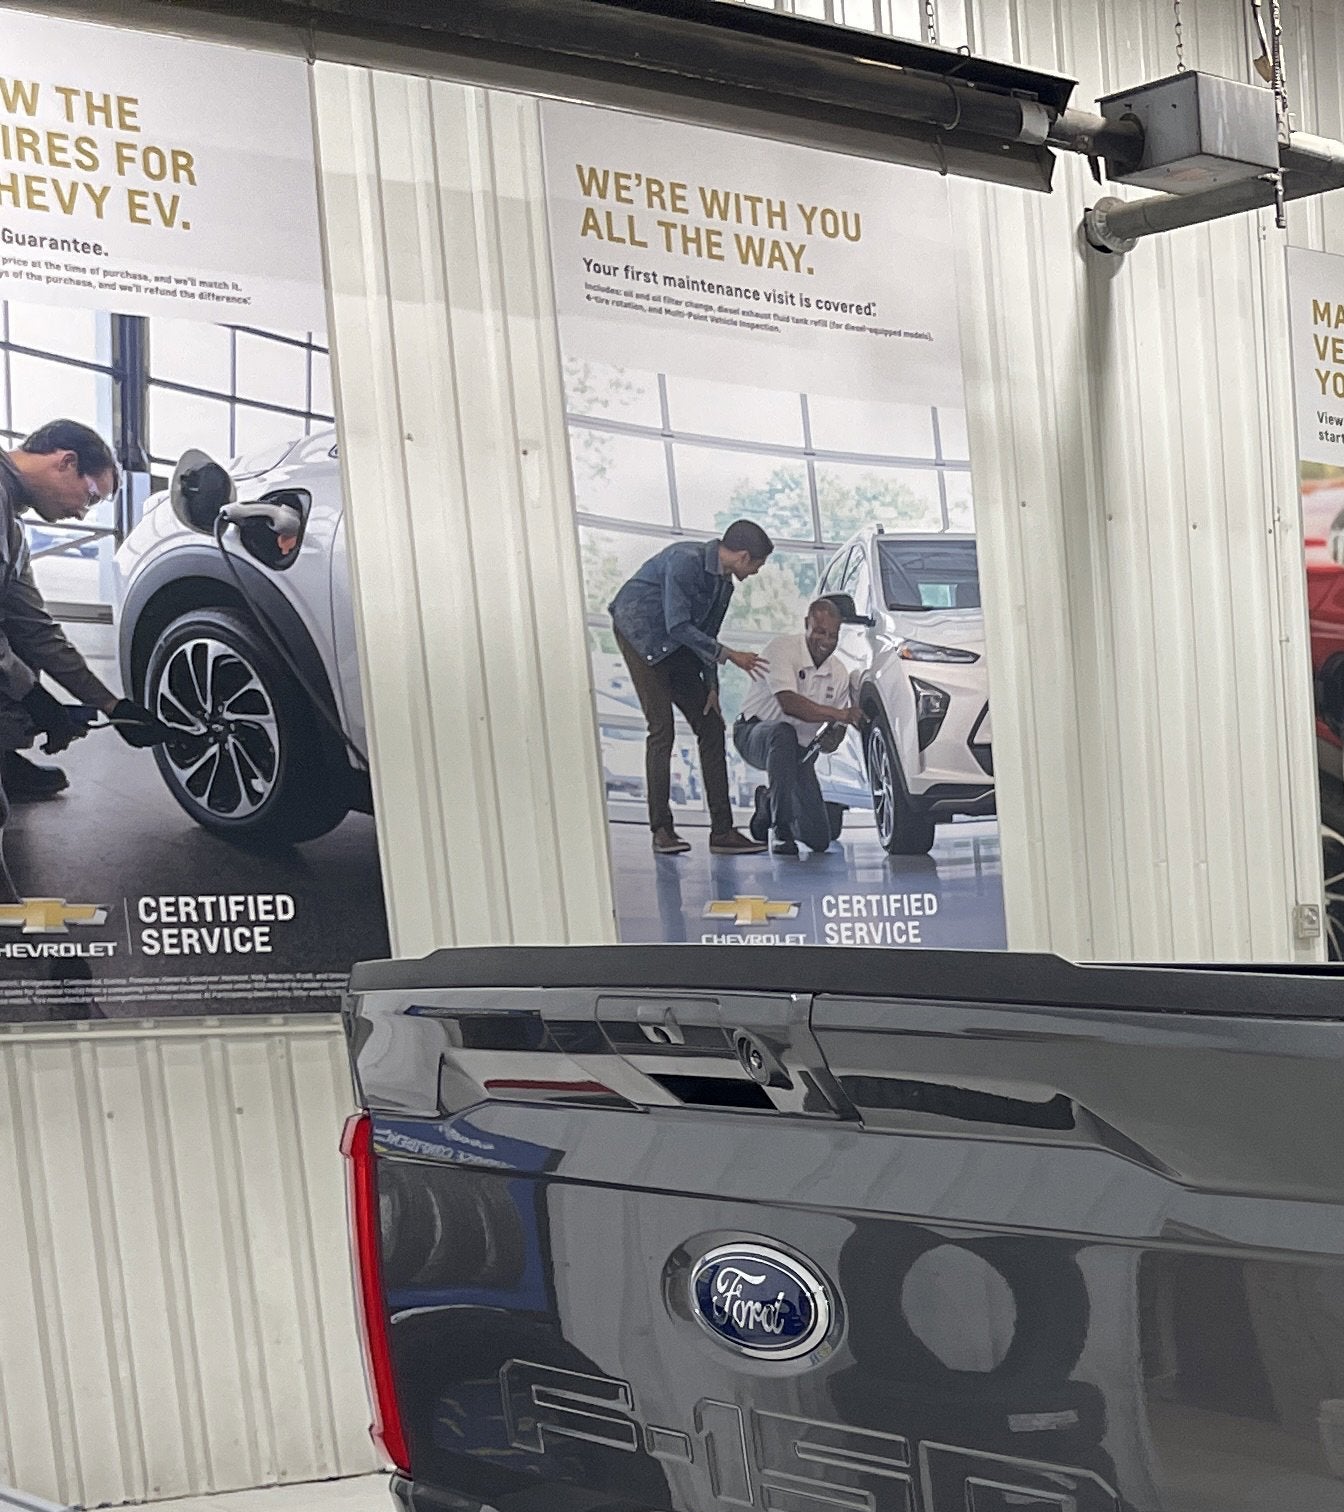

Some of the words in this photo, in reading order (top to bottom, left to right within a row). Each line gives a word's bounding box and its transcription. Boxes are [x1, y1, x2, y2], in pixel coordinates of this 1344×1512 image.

[0, 76, 41, 117] W
[54, 85, 142, 133] THE
[0, 123, 100, 172] IRES
[114, 141, 198, 187] FOR
[0, 171, 112, 220] HEVY
[127, 187, 191, 231] EV.
[575, 163, 690, 215] WE'RE
[697, 186, 788, 232] WITH
[796, 202, 863, 243] YOU
[1, 227, 109, 257] Guarantee.
[579, 206, 649, 249] ALL
[656, 219, 726, 262] THE
[733, 232, 815, 275] WAY.
[44, 261, 61, 271] the
[582, 256, 620, 277] Your
[623, 264, 659, 286] first
[662, 274, 761, 301] maintenance
[763, 288, 797, 307] visit
[798, 292, 812, 309] is
[1316, 410, 1344, 427] View
[137, 893, 297, 925] CERTIFIED
[821, 893, 939, 919] CERTIFIED
[140, 925, 274, 957] SERVICE
[700, 933, 807, 945] CHEVROLET
[824, 920, 922, 945] SERVICE
[0, 941, 118, 959] HEVROLET
[711, 1266, 786, 1335] Ford
